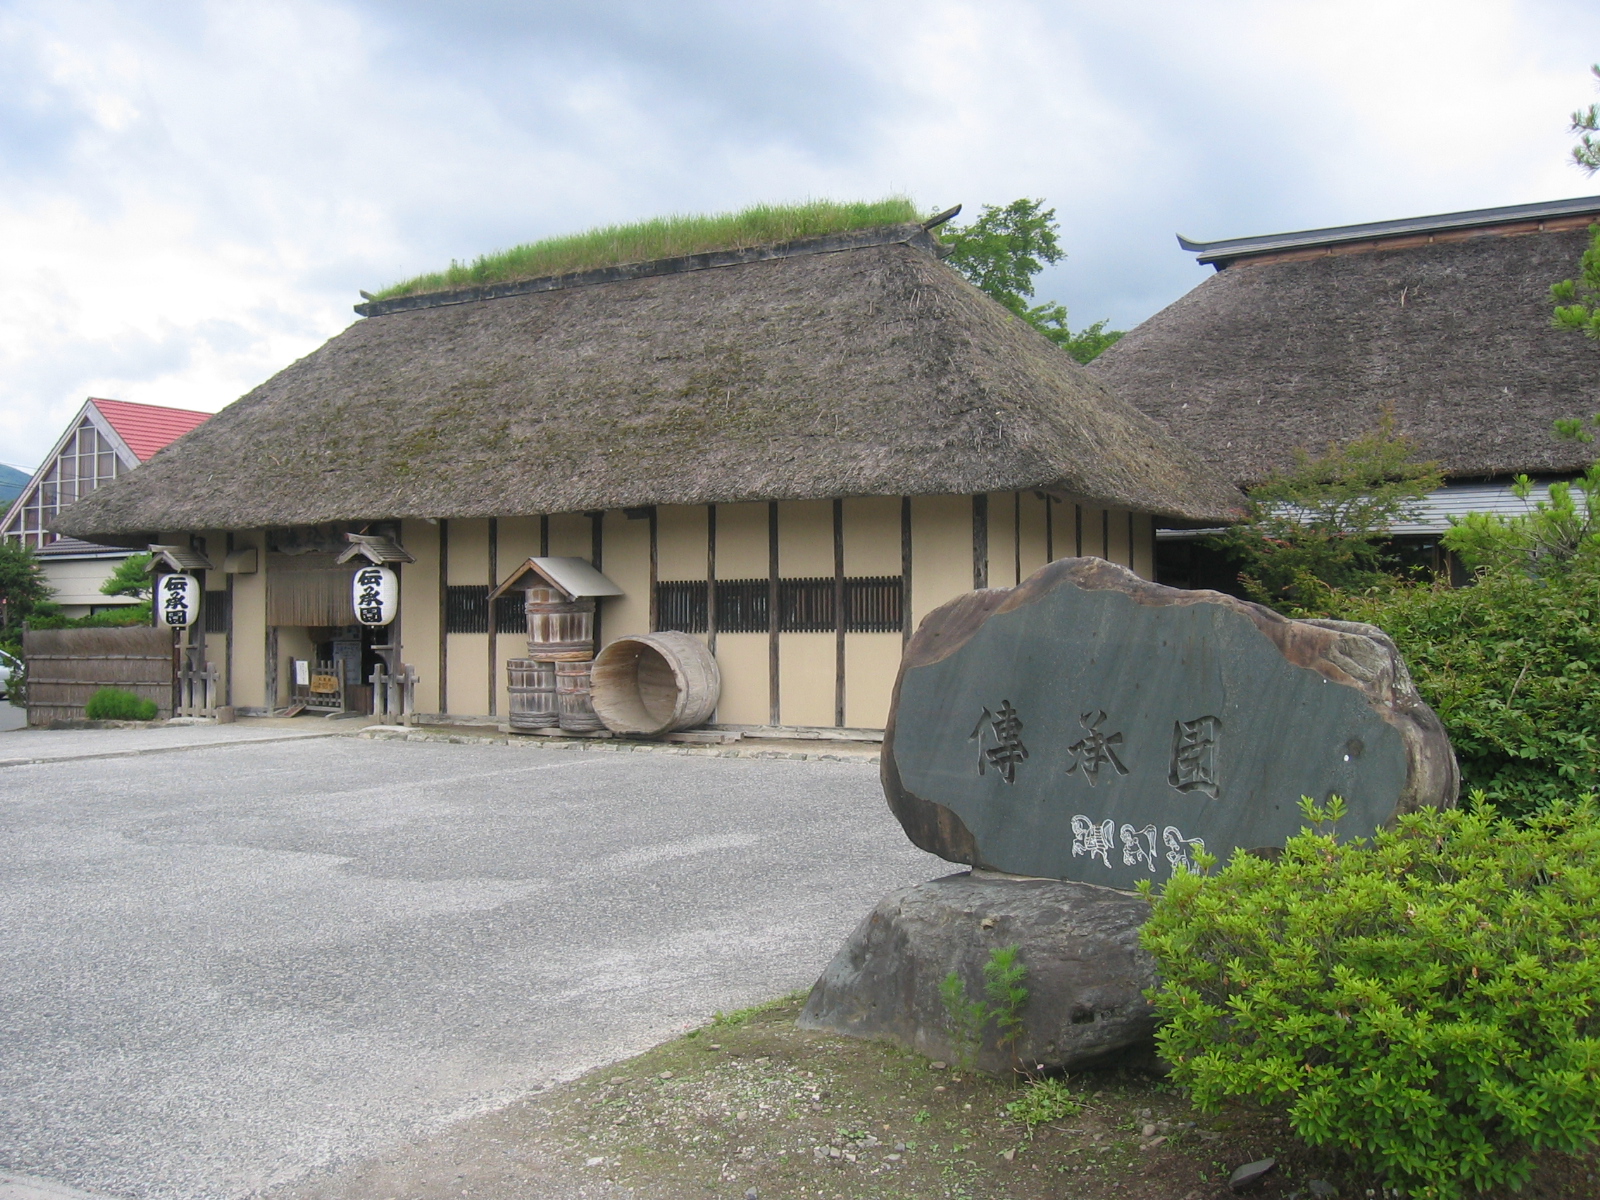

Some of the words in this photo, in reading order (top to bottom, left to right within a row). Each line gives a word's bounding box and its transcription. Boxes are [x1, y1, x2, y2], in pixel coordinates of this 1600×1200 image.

[164, 577, 189, 625] 伝承園
[357, 569, 384, 623] 伝承園
[967, 699, 1222, 800] 傳承園
